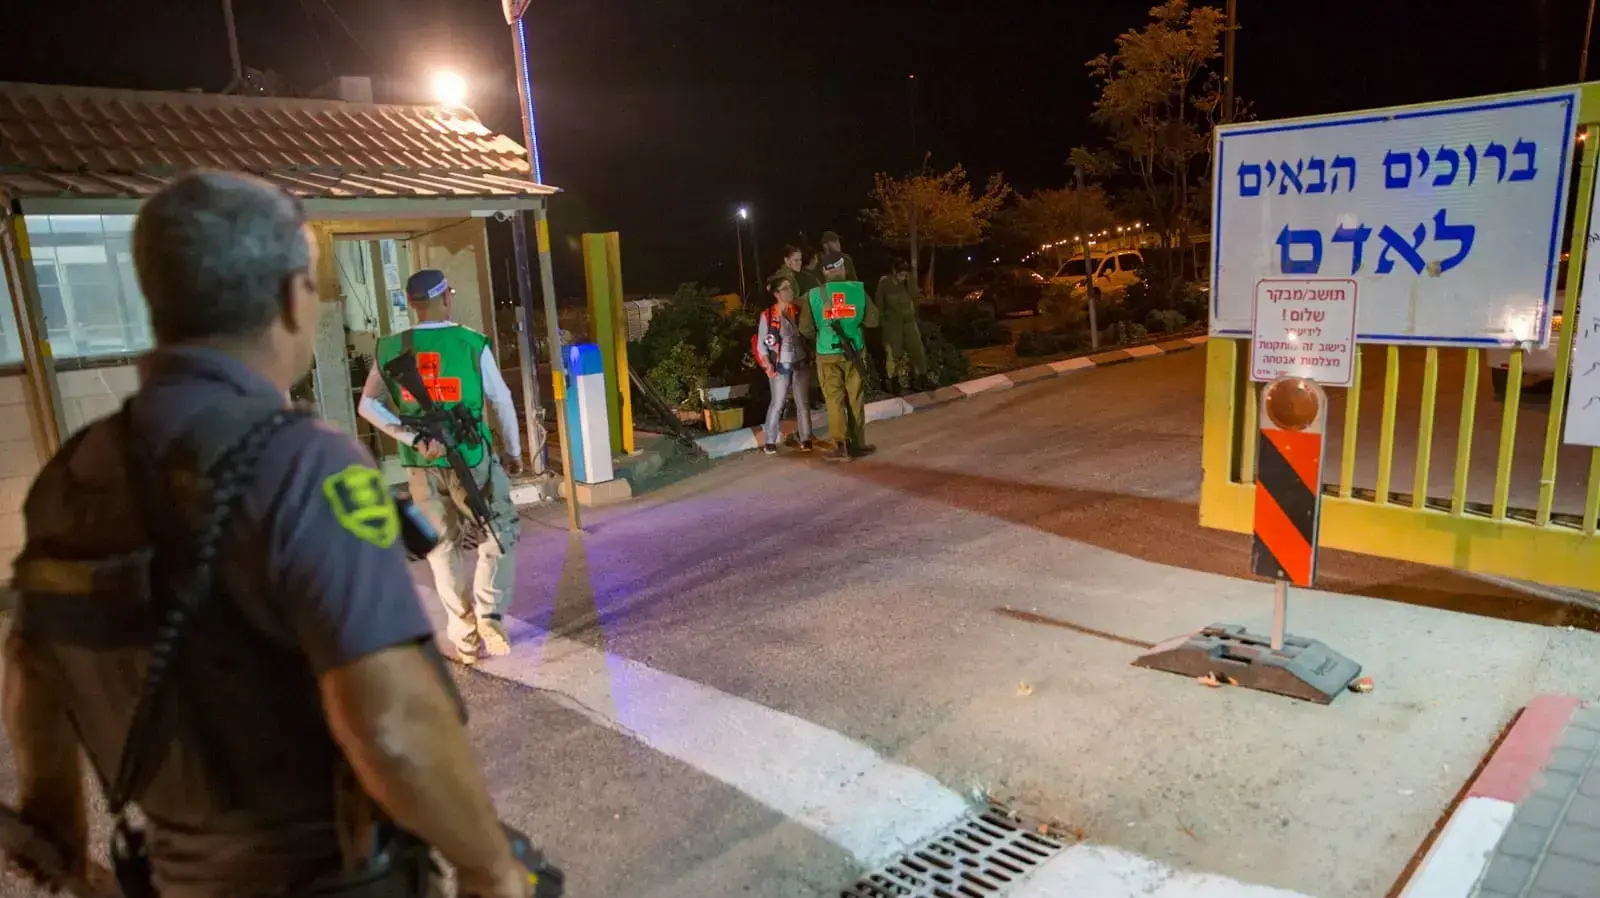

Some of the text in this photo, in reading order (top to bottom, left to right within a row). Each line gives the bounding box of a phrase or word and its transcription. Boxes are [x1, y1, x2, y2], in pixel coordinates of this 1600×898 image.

[1237, 137, 1538, 197] ברוכים הבאים
[1275, 208, 1476, 275] לאדם
[1266, 288, 1345, 303] תושב/מבקר
